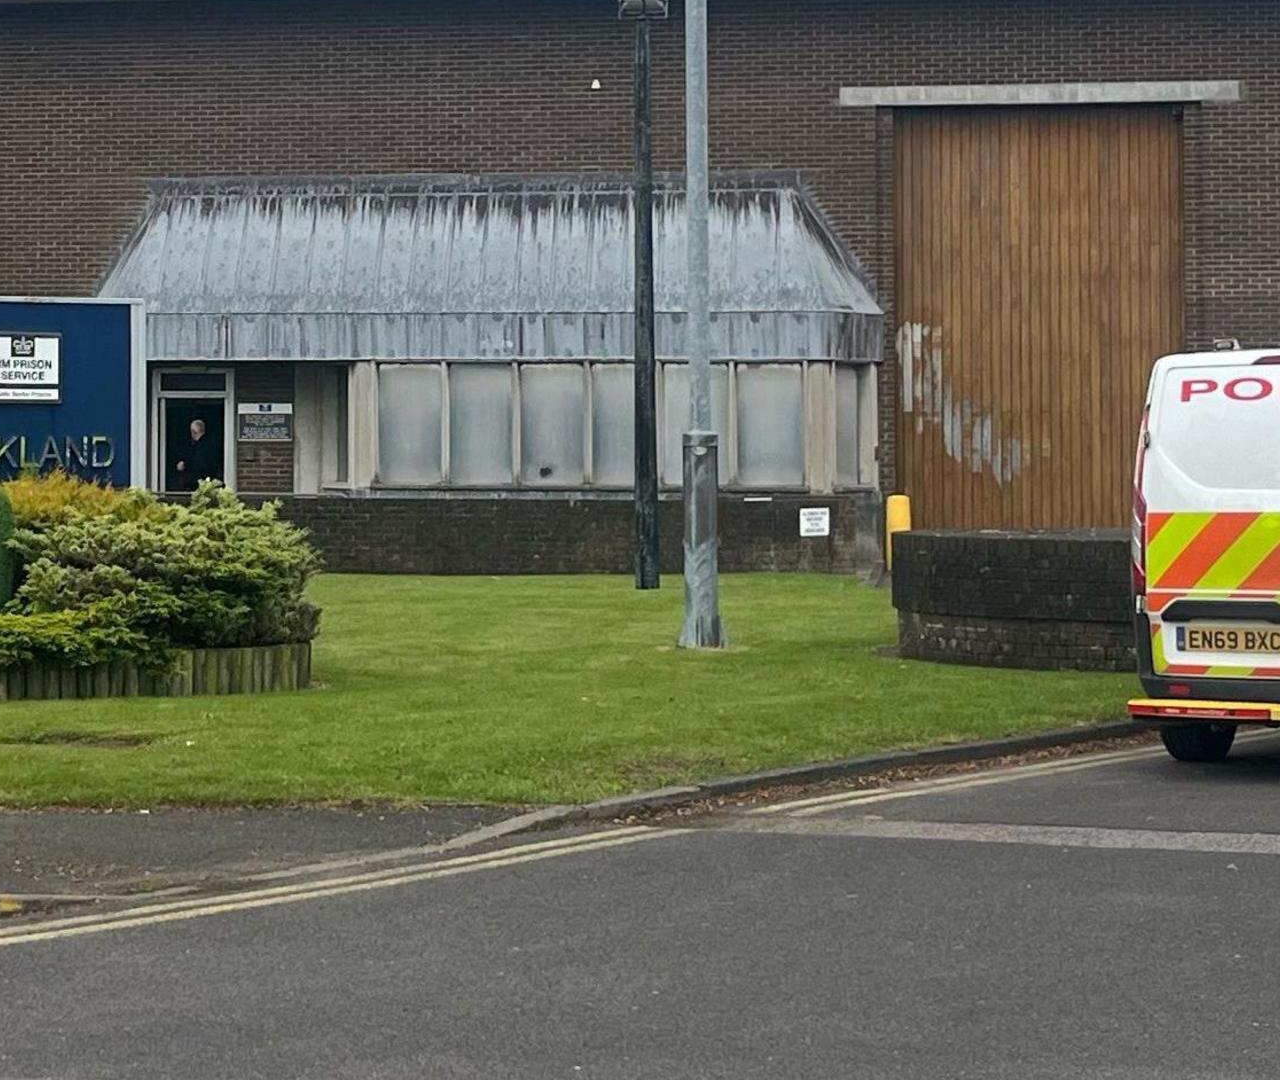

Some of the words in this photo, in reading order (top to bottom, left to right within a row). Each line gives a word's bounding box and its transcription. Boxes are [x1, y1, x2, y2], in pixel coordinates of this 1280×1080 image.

[13, 359, 52, 369] PRISON
[0, 371, 45, 381] SERVICE
[1188, 630, 1239, 649] EN69
